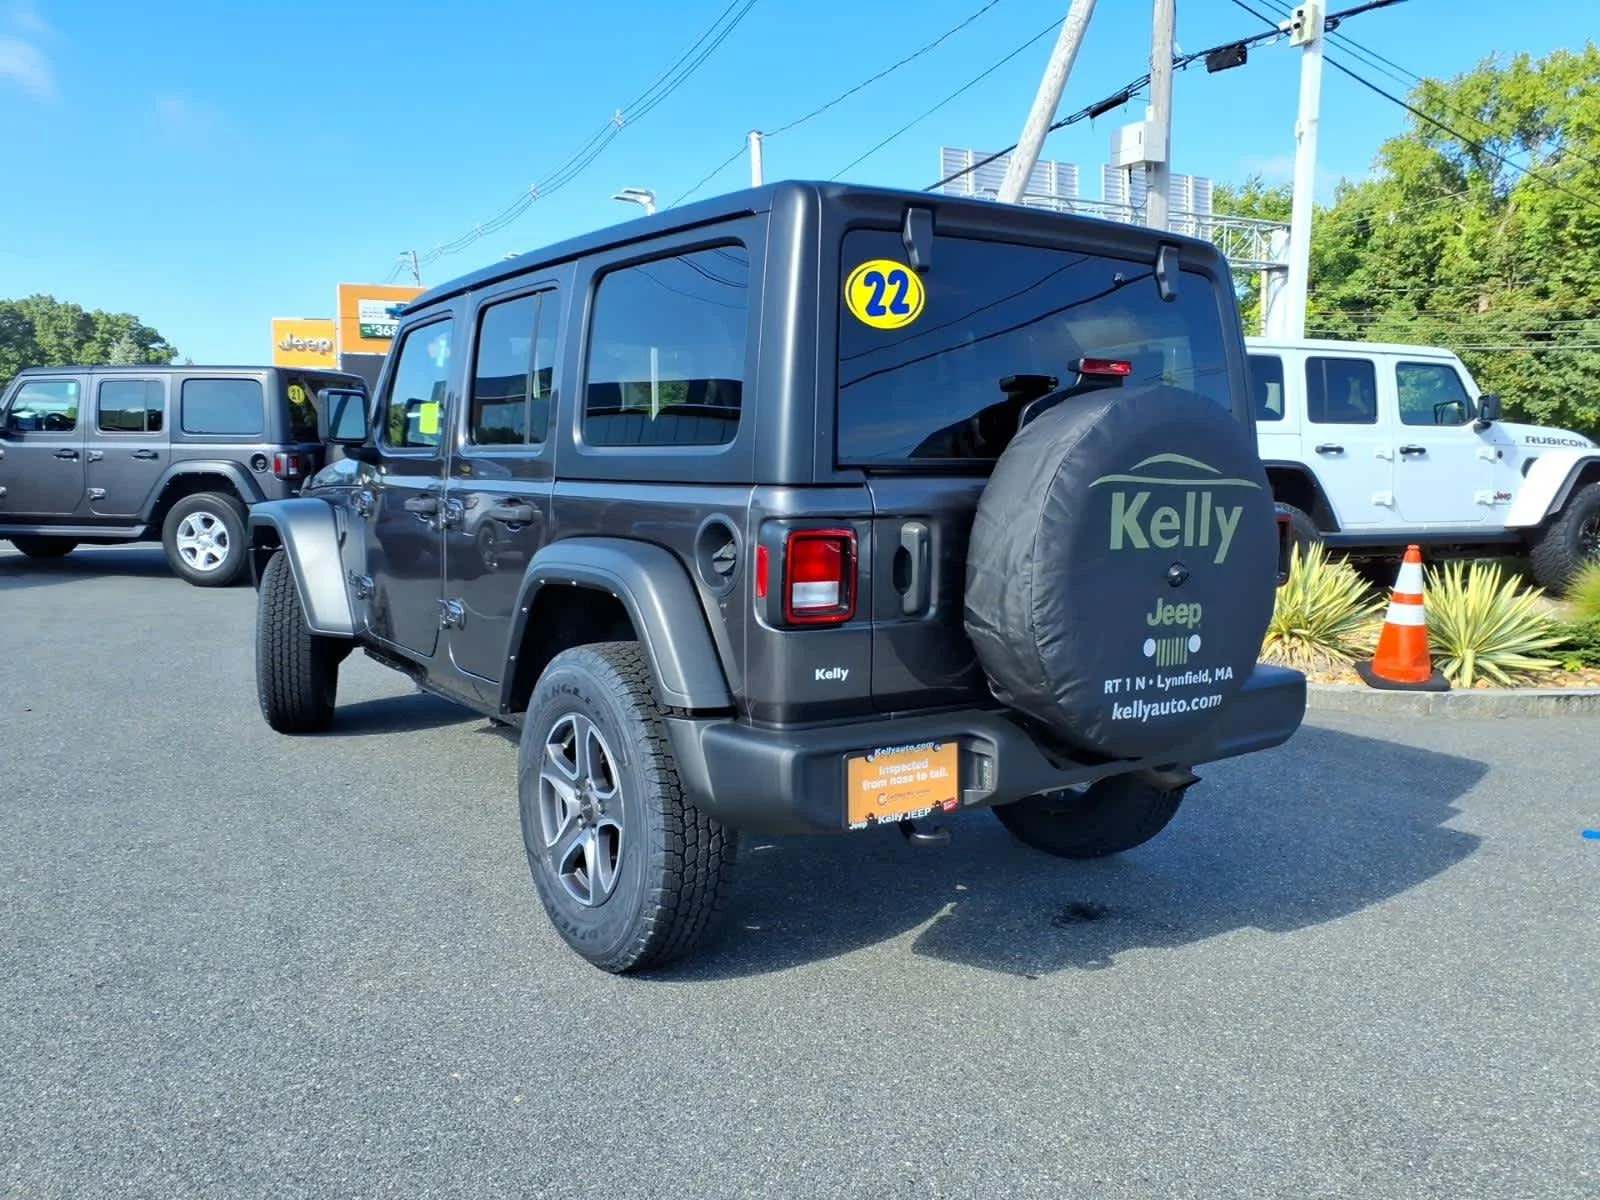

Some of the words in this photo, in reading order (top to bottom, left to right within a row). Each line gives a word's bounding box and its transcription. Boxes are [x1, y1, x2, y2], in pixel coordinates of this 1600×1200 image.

[864, 269, 910, 316] 22
[279, 333, 333, 355] Jeep
[1525, 436, 1588, 448] RUBICON
[1493, 491, 1512, 501] Jeep
[1109, 491, 1243, 564] Kelly
[1146, 597, 1202, 629] Jeep
[815, 667, 849, 681] Kelly
[1104, 678, 1122, 695] RT
[1126, 677, 1131, 691] 1
[1135, 675, 1145, 691] N
[1157, 671, 1212, 691] Lynnfield,
[1215, 666, 1233, 682] MA
[1111, 694, 1222, 722] kellyauto.com
[874, 742, 934, 757] Kellyauto.com
[879, 758, 929, 776] Inspected
[862, 779, 888, 791] from
[890, 775, 914, 785] nose
[916, 771, 928, 781] to
[877, 811, 904, 825] Kelly
[904, 807, 932, 820] JEEP
